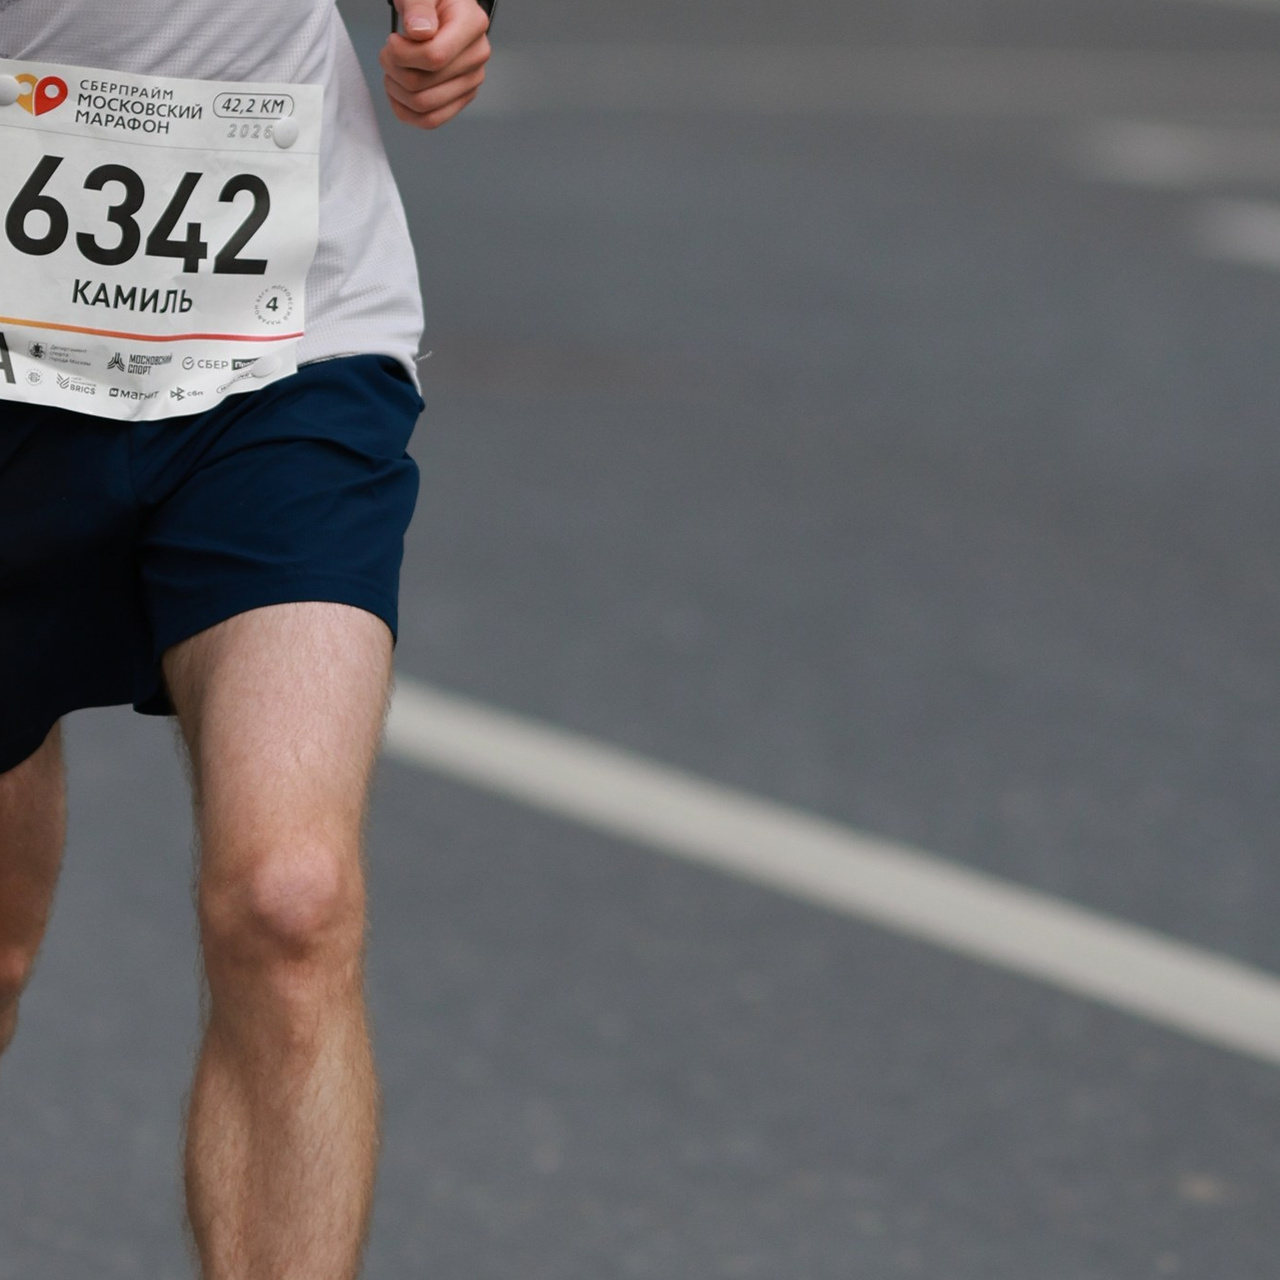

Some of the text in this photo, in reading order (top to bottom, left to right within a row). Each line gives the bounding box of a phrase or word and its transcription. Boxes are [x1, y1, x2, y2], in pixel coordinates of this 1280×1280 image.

[79, 79, 174, 100] СБЕРПРАЙМ
[77, 93, 203, 120] МОСКОВСКИЙ
[221, 97, 256, 115] 42,2
[75, 110, 170, 135] МАРАФОН
[5, 154, 271, 275] 6342
[71, 278, 193, 314] КАМИЛЬ
[265, 296, 279, 312] 4
[127, 363, 152, 375] СПОРТ
[197, 359, 229, 370] СБЕР
[70, 383, 96, 395] BRICS
